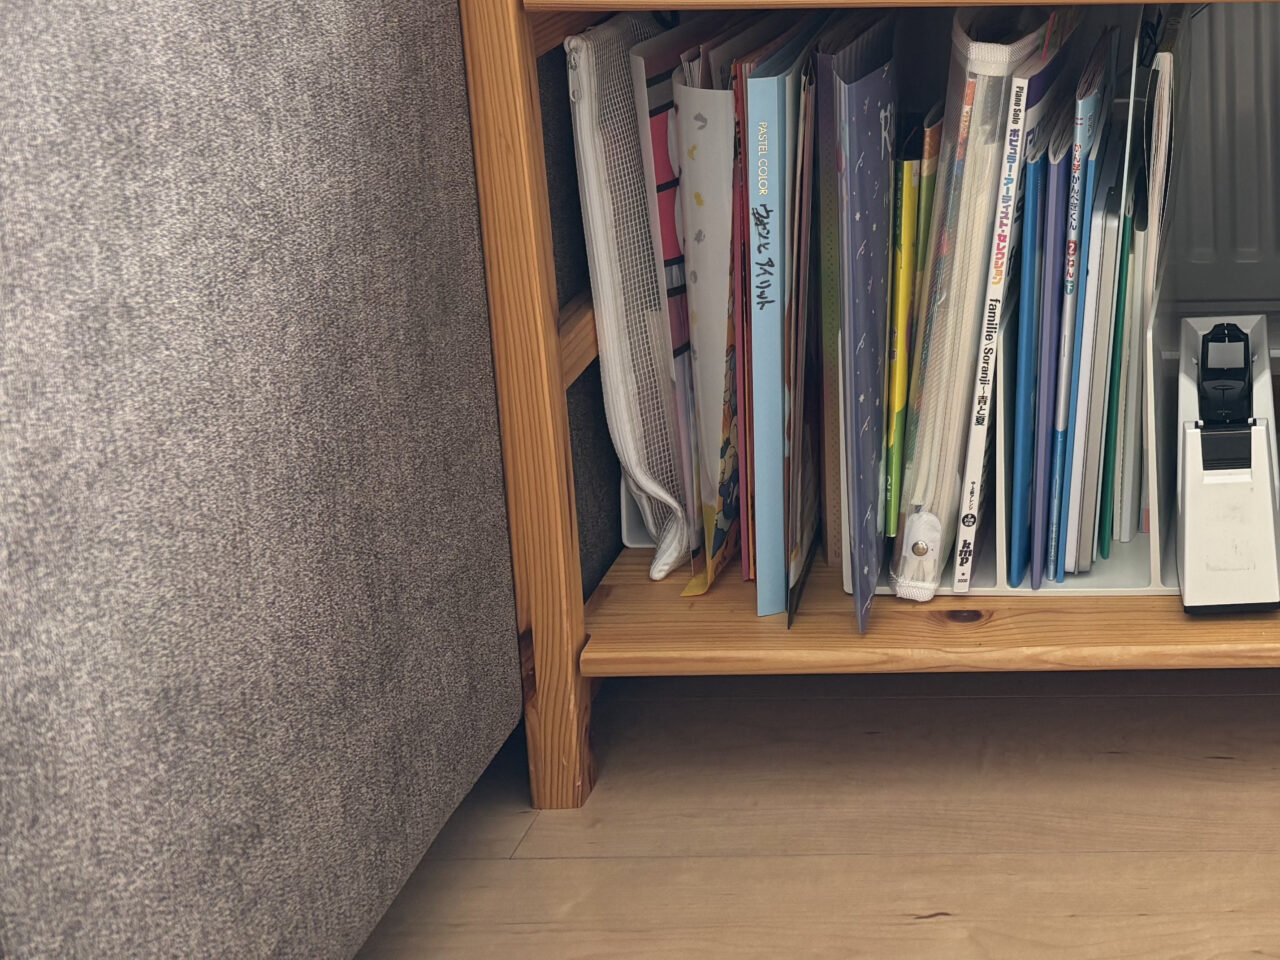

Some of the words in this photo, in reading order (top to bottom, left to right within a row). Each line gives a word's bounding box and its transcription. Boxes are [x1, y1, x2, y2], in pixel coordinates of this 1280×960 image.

[1013, 85, 1025, 107] Piano
[1011, 108, 1022, 125] Solo
[758, 121, 768, 156] PASTEL
[758, 158, 768, 196] COLOR
[959, 539, 973, 567] kmp
